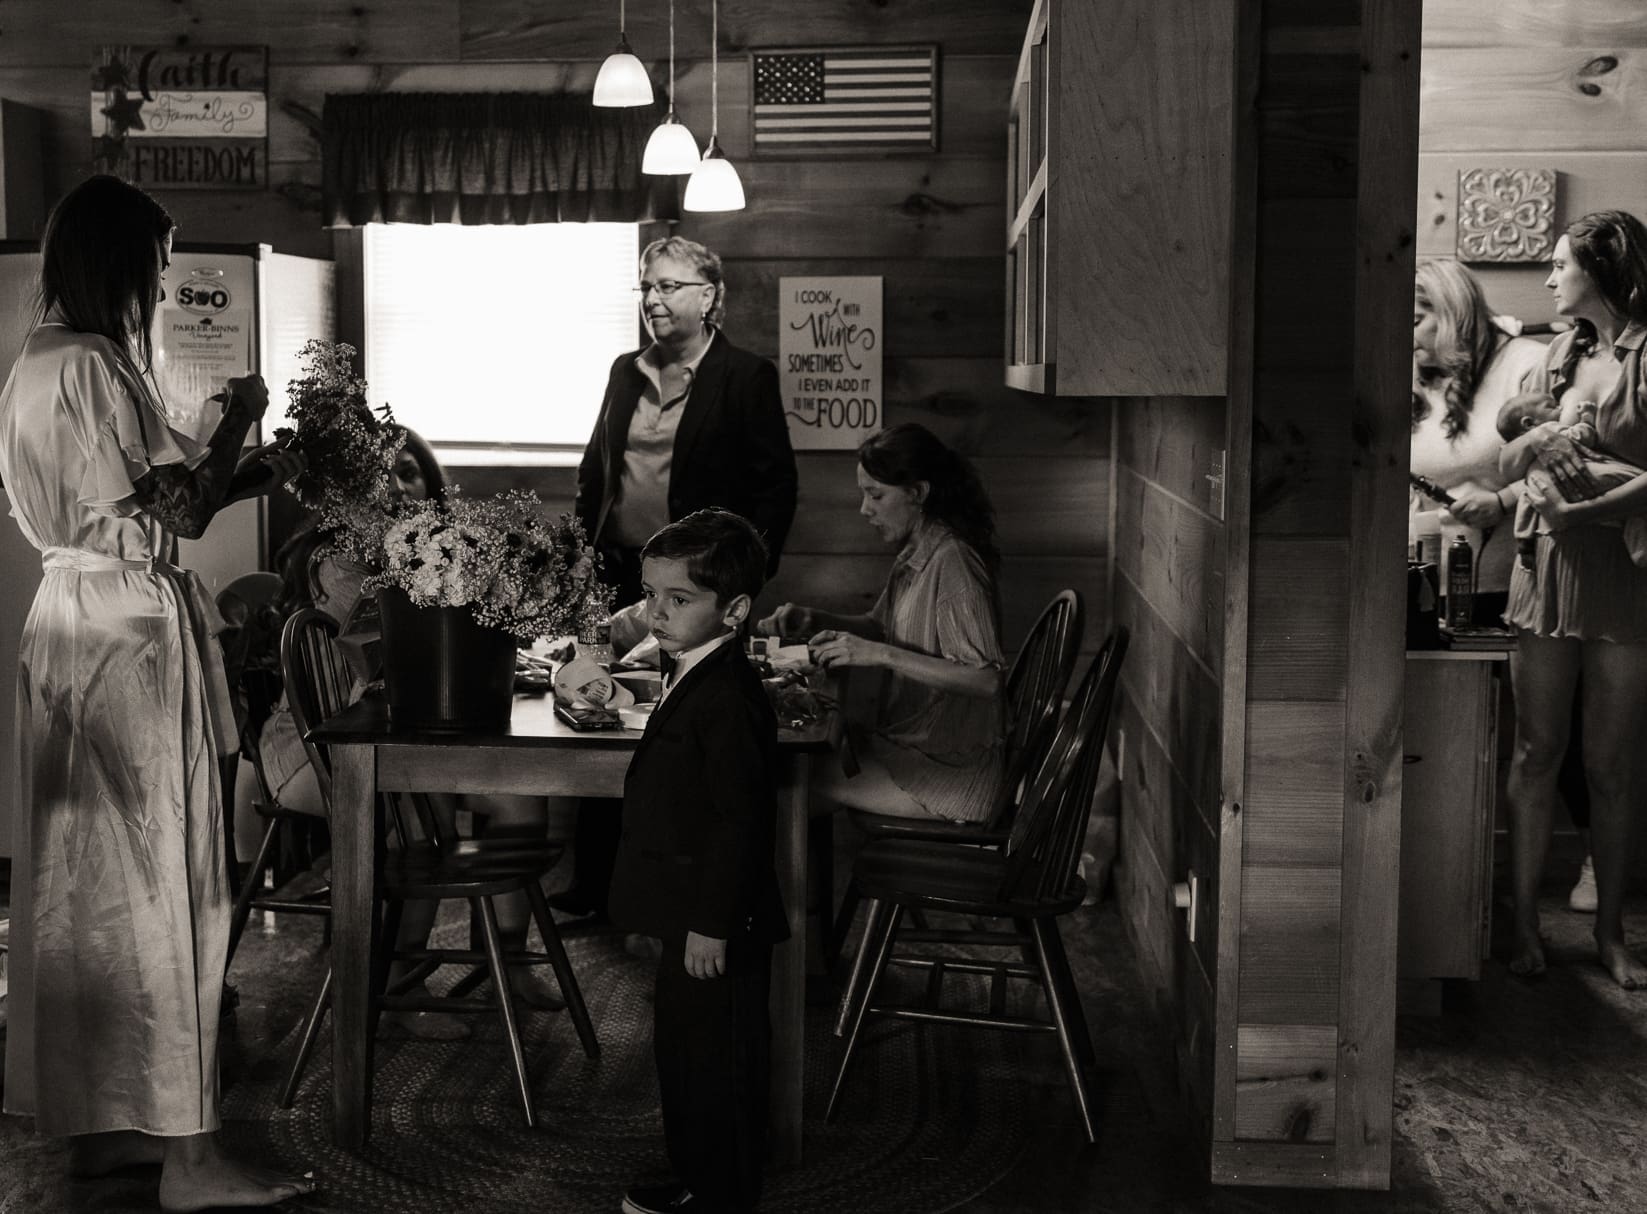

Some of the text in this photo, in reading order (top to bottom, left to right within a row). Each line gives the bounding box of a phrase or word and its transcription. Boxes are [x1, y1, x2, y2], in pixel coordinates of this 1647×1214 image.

[149, 94, 254, 133] Family
[134, 145, 257, 184] FREEDOM
[795, 290, 832, 304] I COOK
[843, 303, 860, 316] WITH
[790, 298, 875, 370] Wine
[788, 354, 844, 373] SOMETIMES
[804, 379, 832, 392] EVEN
[835, 379, 859, 392] ADD
[861, 379, 871, 392] IT
[793, 397, 877, 429] TO THE FOOD
